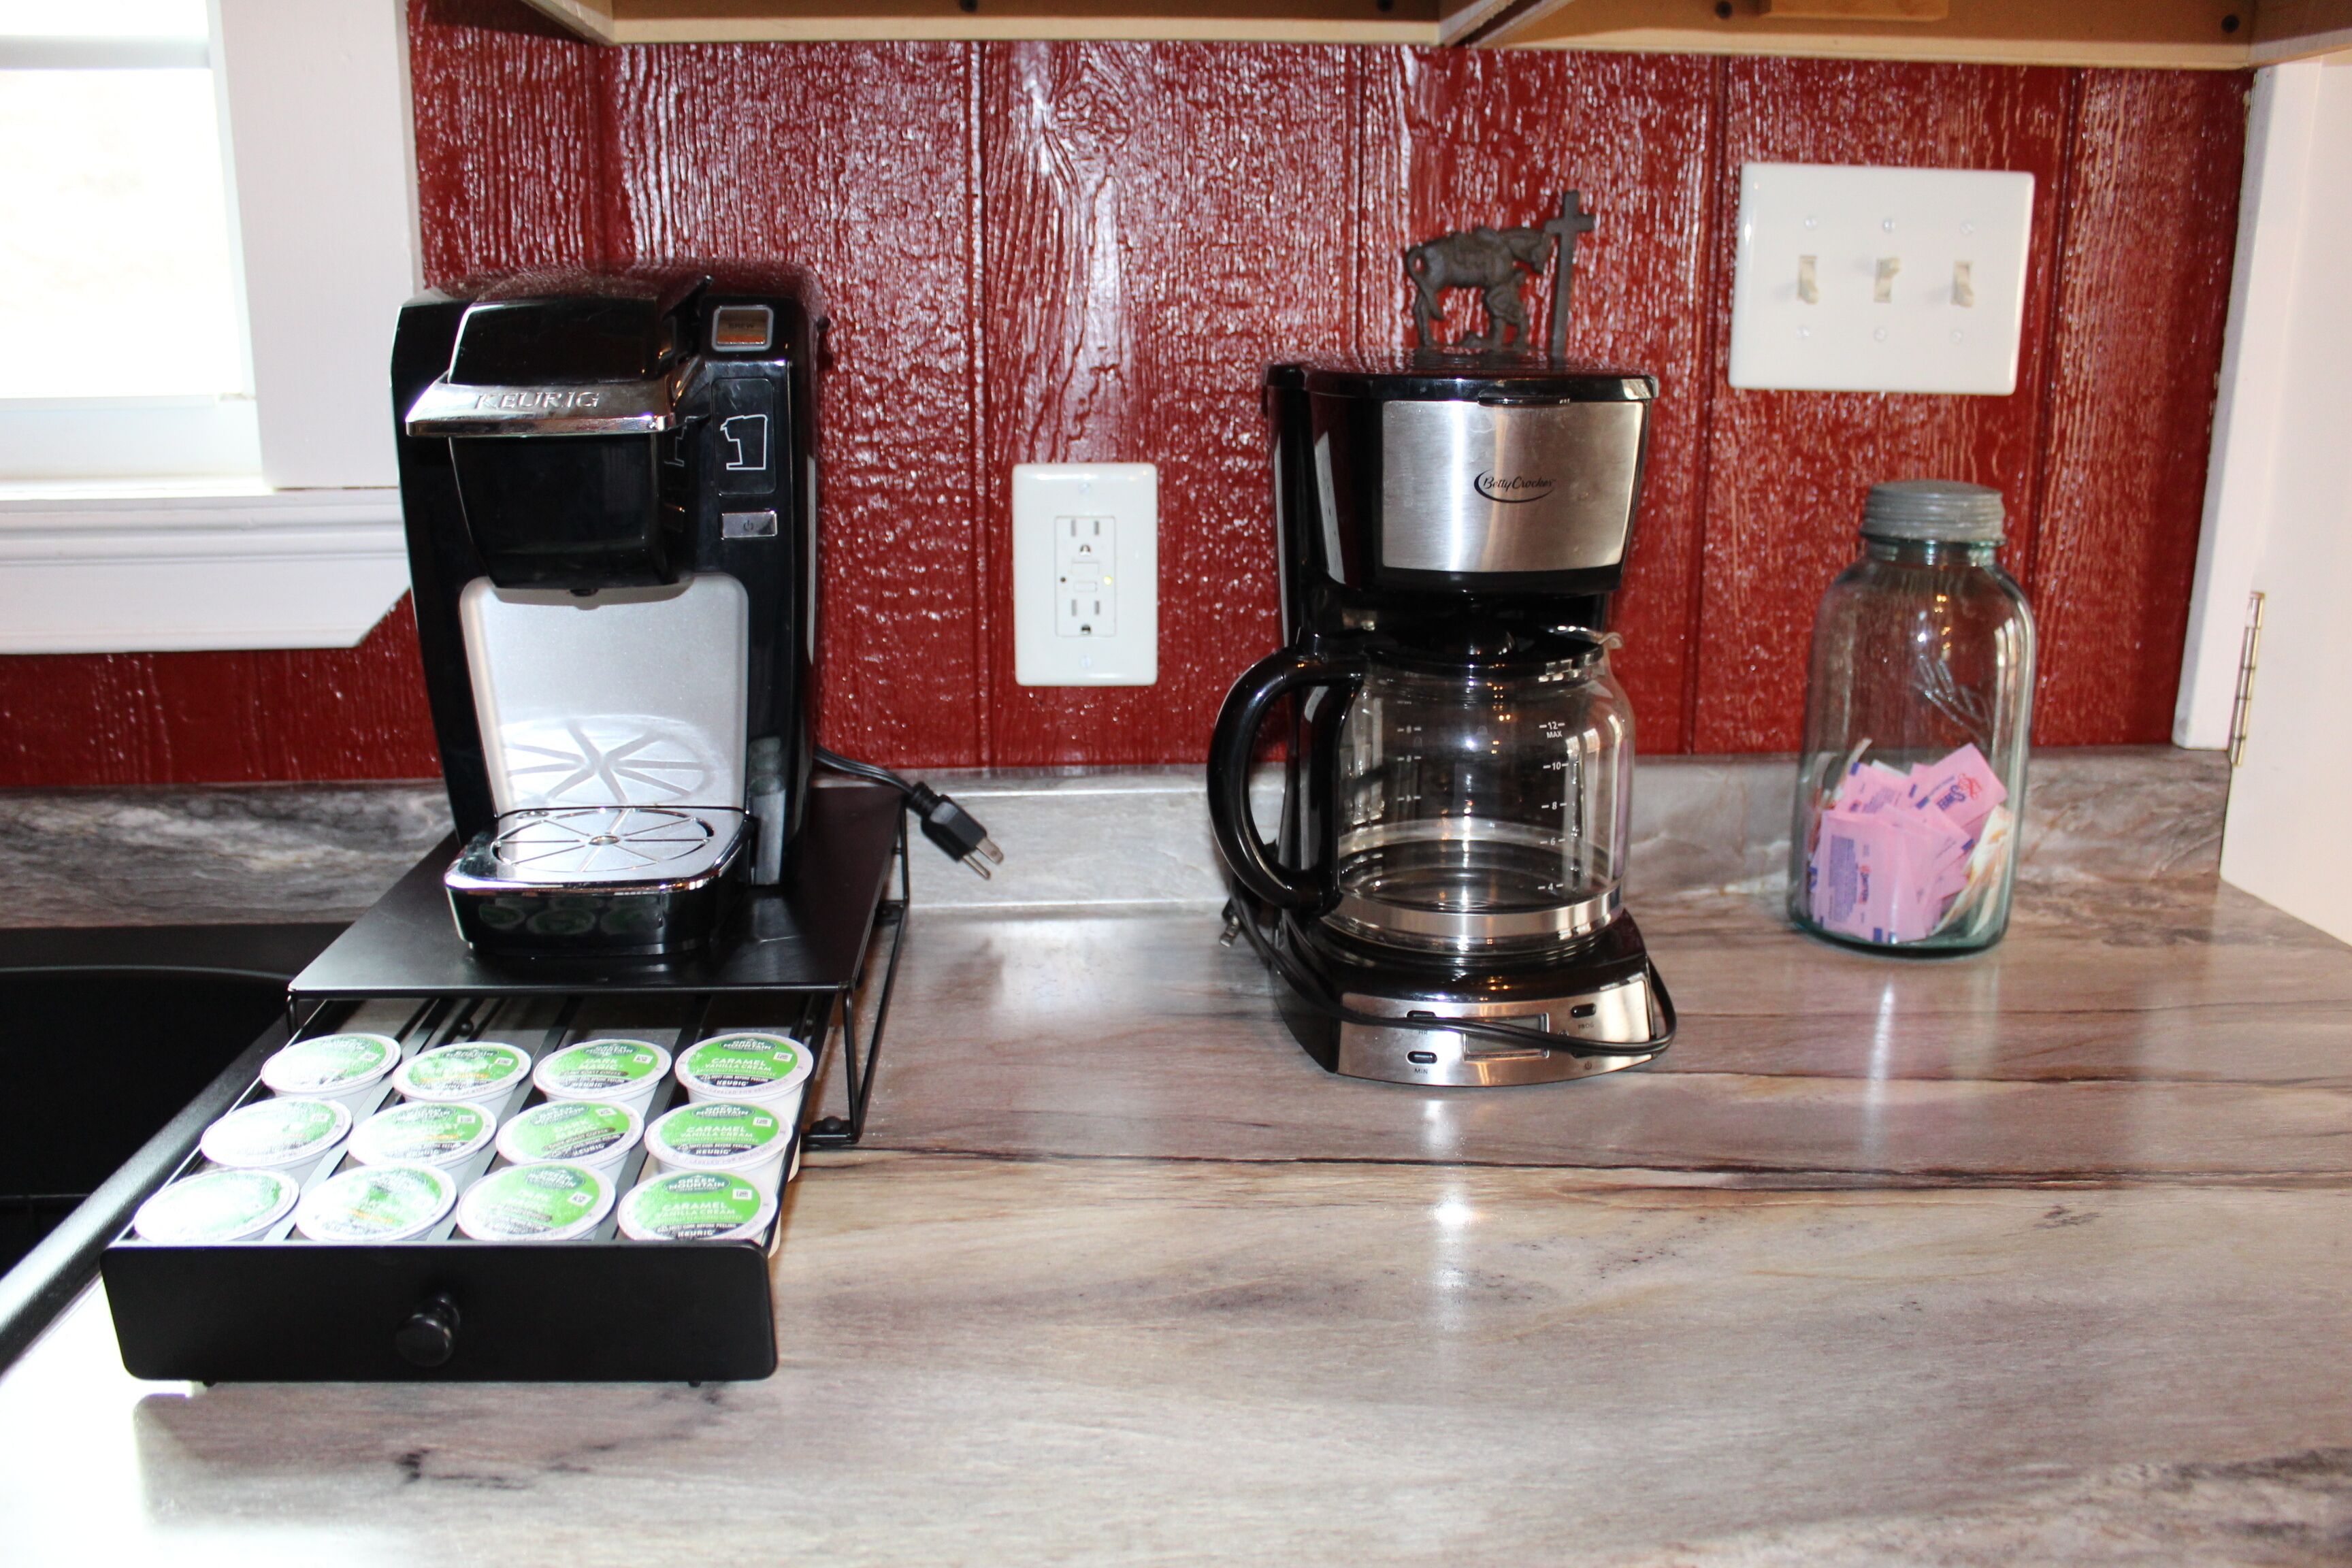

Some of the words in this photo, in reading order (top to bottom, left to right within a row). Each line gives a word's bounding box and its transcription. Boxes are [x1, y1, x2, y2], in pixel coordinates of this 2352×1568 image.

[474, 391, 600, 409] KEURIG
[1483, 476, 1512, 492] Betty
[1512, 475, 1553, 489] Crocker
[1547, 721, 1558, 730] 12
[1546, 730, 1563, 739] MAX
[1552, 762, 1562, 770] 10
[1552, 801, 1558, 811] 8
[1550, 837, 1556, 845] 6
[711, 1058, 766, 1066] CARAMEL
[740, 1063, 772, 1071] CREAM
[668, 1181, 725, 1190] MOUNTAIN
[662, 1202, 727, 1211] CARAMEL
[656, 1209, 698, 1217] VANILLA
